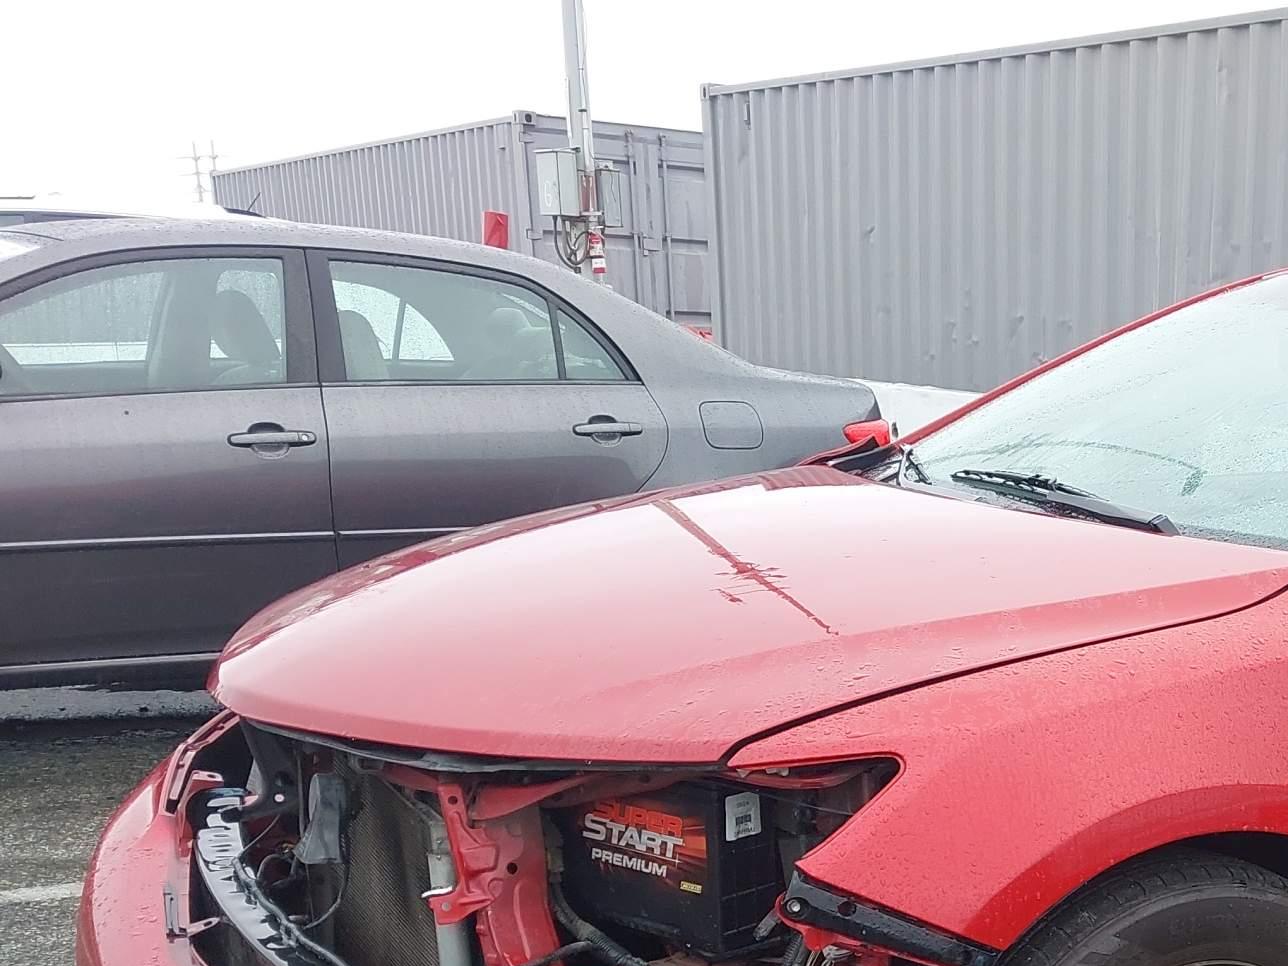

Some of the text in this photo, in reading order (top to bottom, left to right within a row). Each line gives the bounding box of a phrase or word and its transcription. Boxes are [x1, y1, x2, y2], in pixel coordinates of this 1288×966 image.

[582, 813, 685, 858] START
[591, 801, 683, 836] SUPER
[591, 847, 667, 878] PREMIUM
